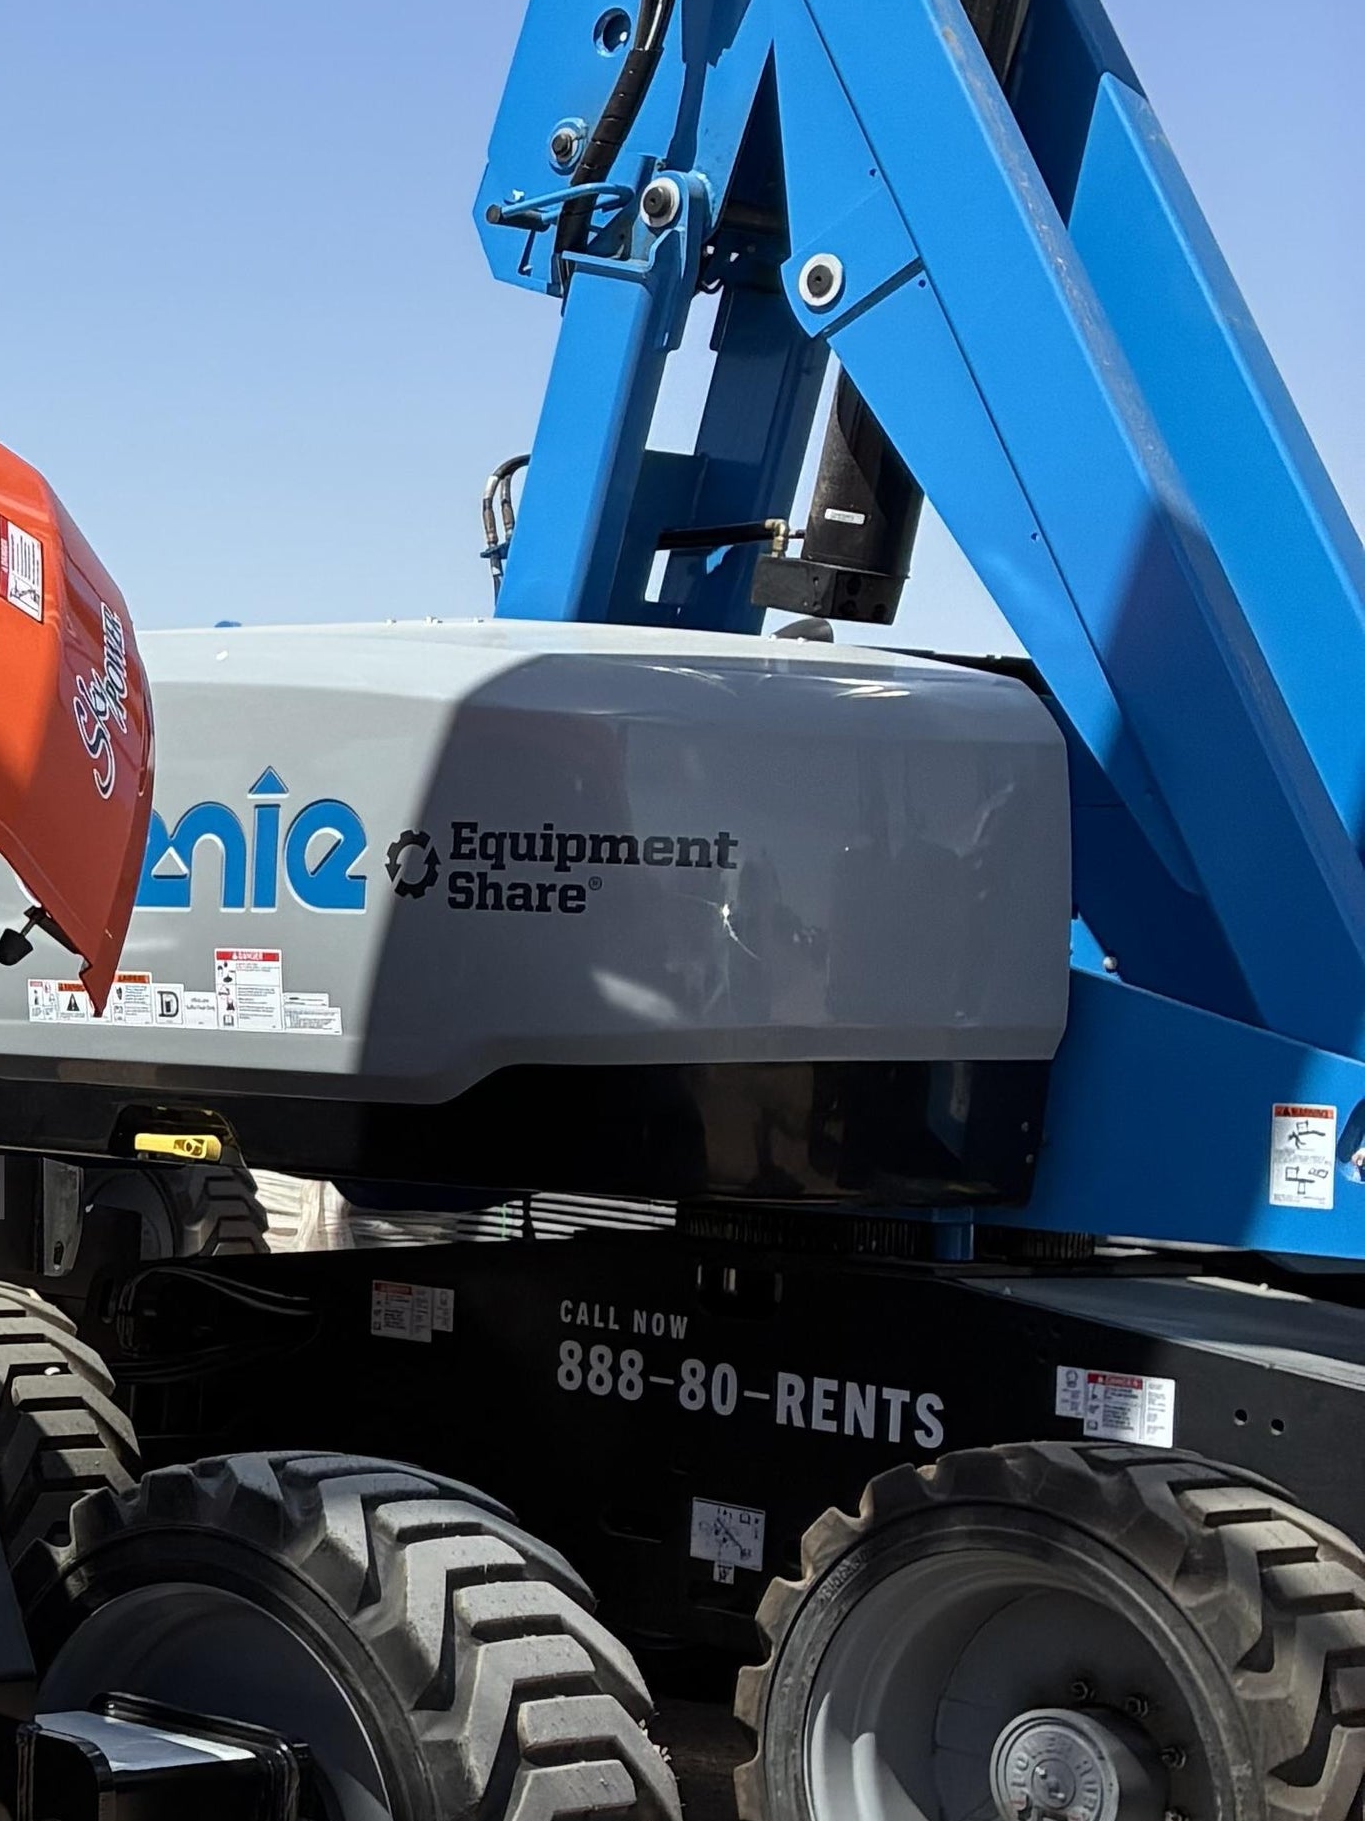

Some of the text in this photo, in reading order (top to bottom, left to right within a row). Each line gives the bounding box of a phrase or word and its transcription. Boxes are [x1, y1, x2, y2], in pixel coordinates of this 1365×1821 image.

[449, 822, 739, 872] Equipment
[448, 871, 587, 914] Share
[560, 1300, 688, 1340] CALL NOW
[557, 1340, 945, 1449] 888-80-RENTS
